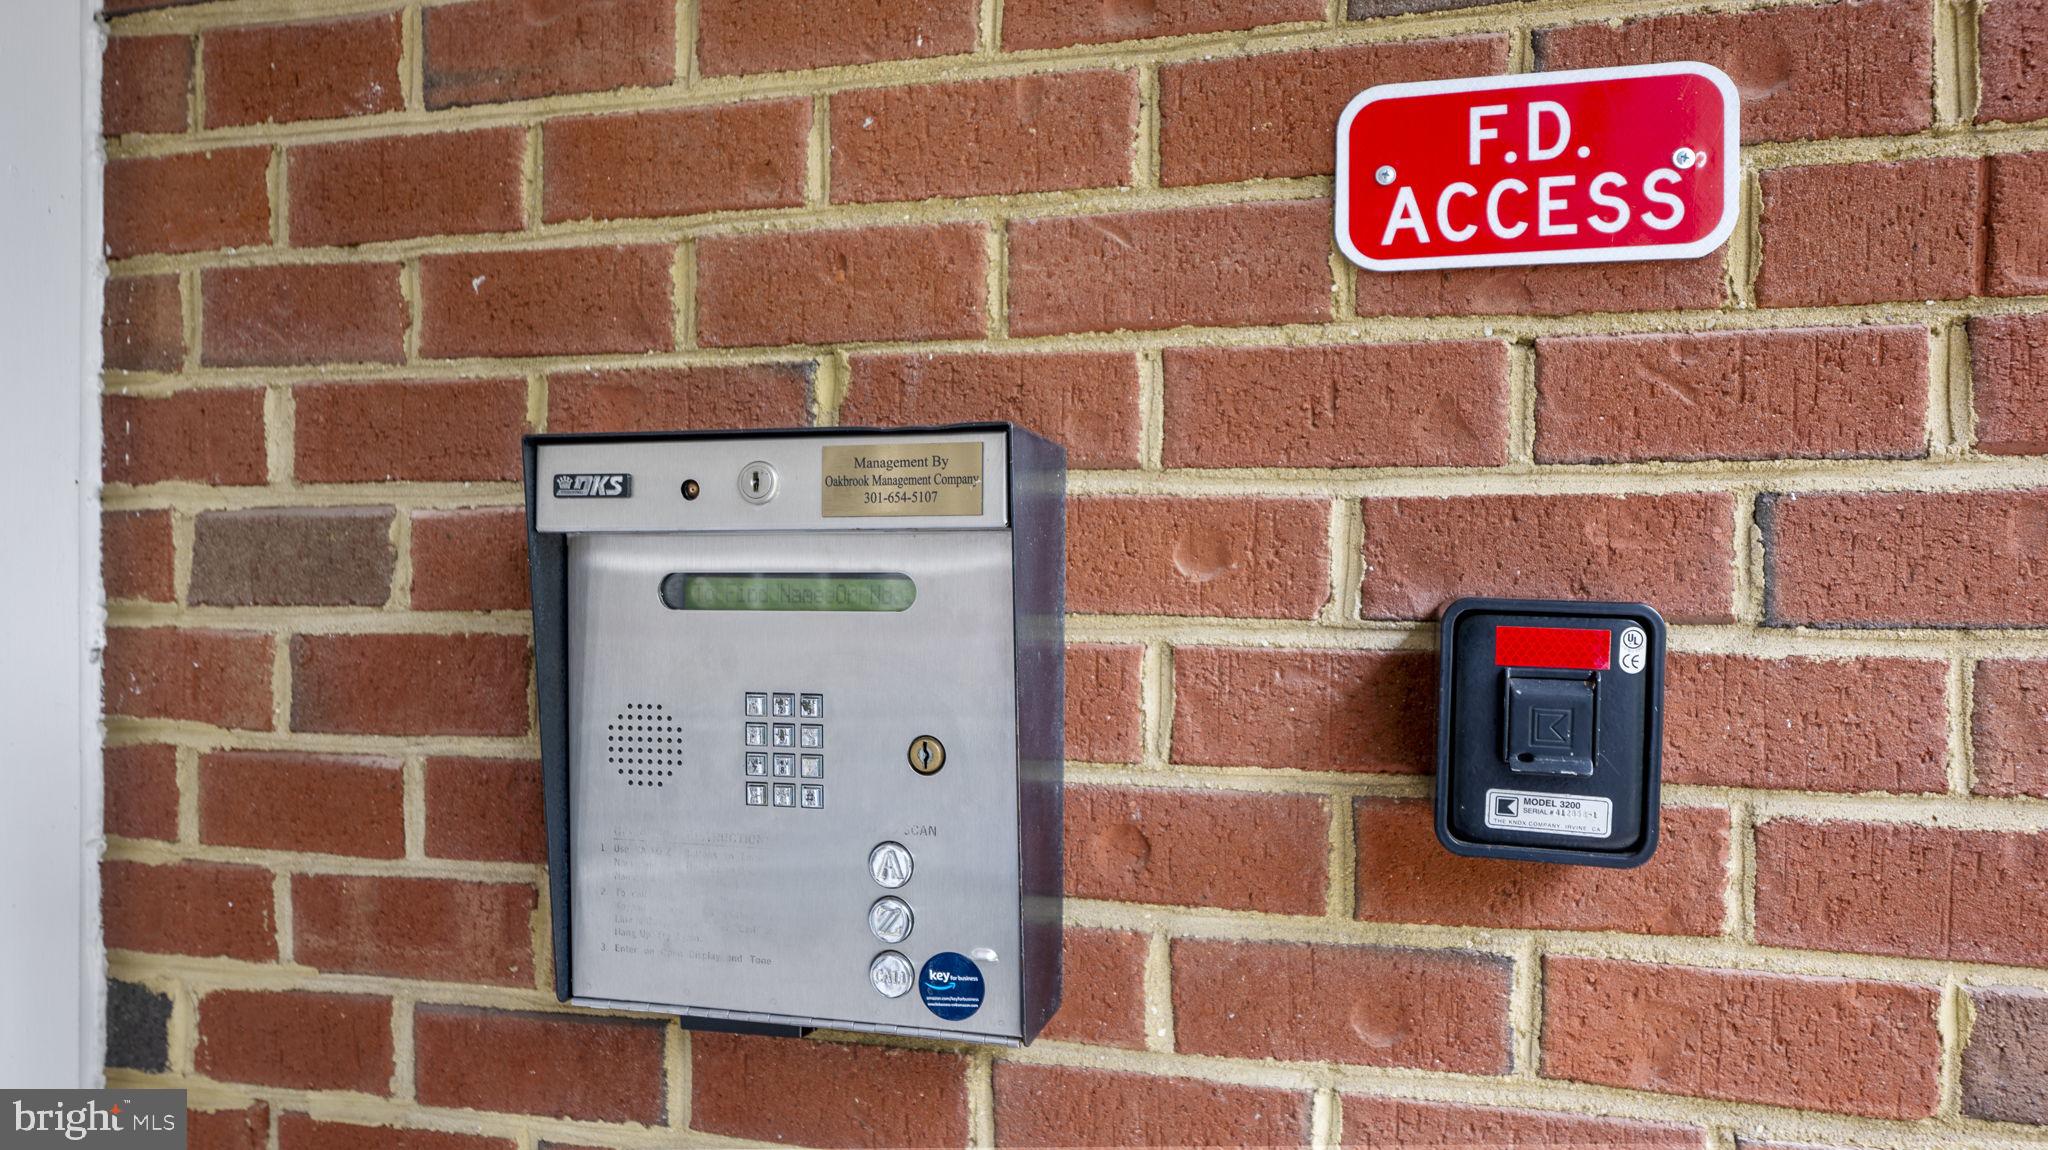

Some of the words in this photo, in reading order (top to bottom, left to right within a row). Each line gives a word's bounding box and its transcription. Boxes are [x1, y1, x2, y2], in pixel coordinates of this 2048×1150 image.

[1469, 100, 1590, 165] F.D.
[1380, 168, 1685, 246] ACCESS
[853, 456, 928, 471] Management
[932, 454, 949, 470] By
[573, 475, 623, 496] DKS
[824, 475, 869, 487] Oakbrook
[872, 473, 931, 488] Management
[933, 473, 979, 488] Company
[864, 490, 938, 504] 301-654-5107
[778, 583, 824, 604] Name
[1622, 653, 1639, 669] CE
[1523, 797, 1557, 808] MODEL
[1560, 800, 1581, 810] 3200
[1523, 807, 1548, 816] SERIAL
[1508, 818, 1527, 826] KNOX
[877, 849, 904, 881] A
[879, 905, 902, 935] Z
[929, 969, 951, 983] key
